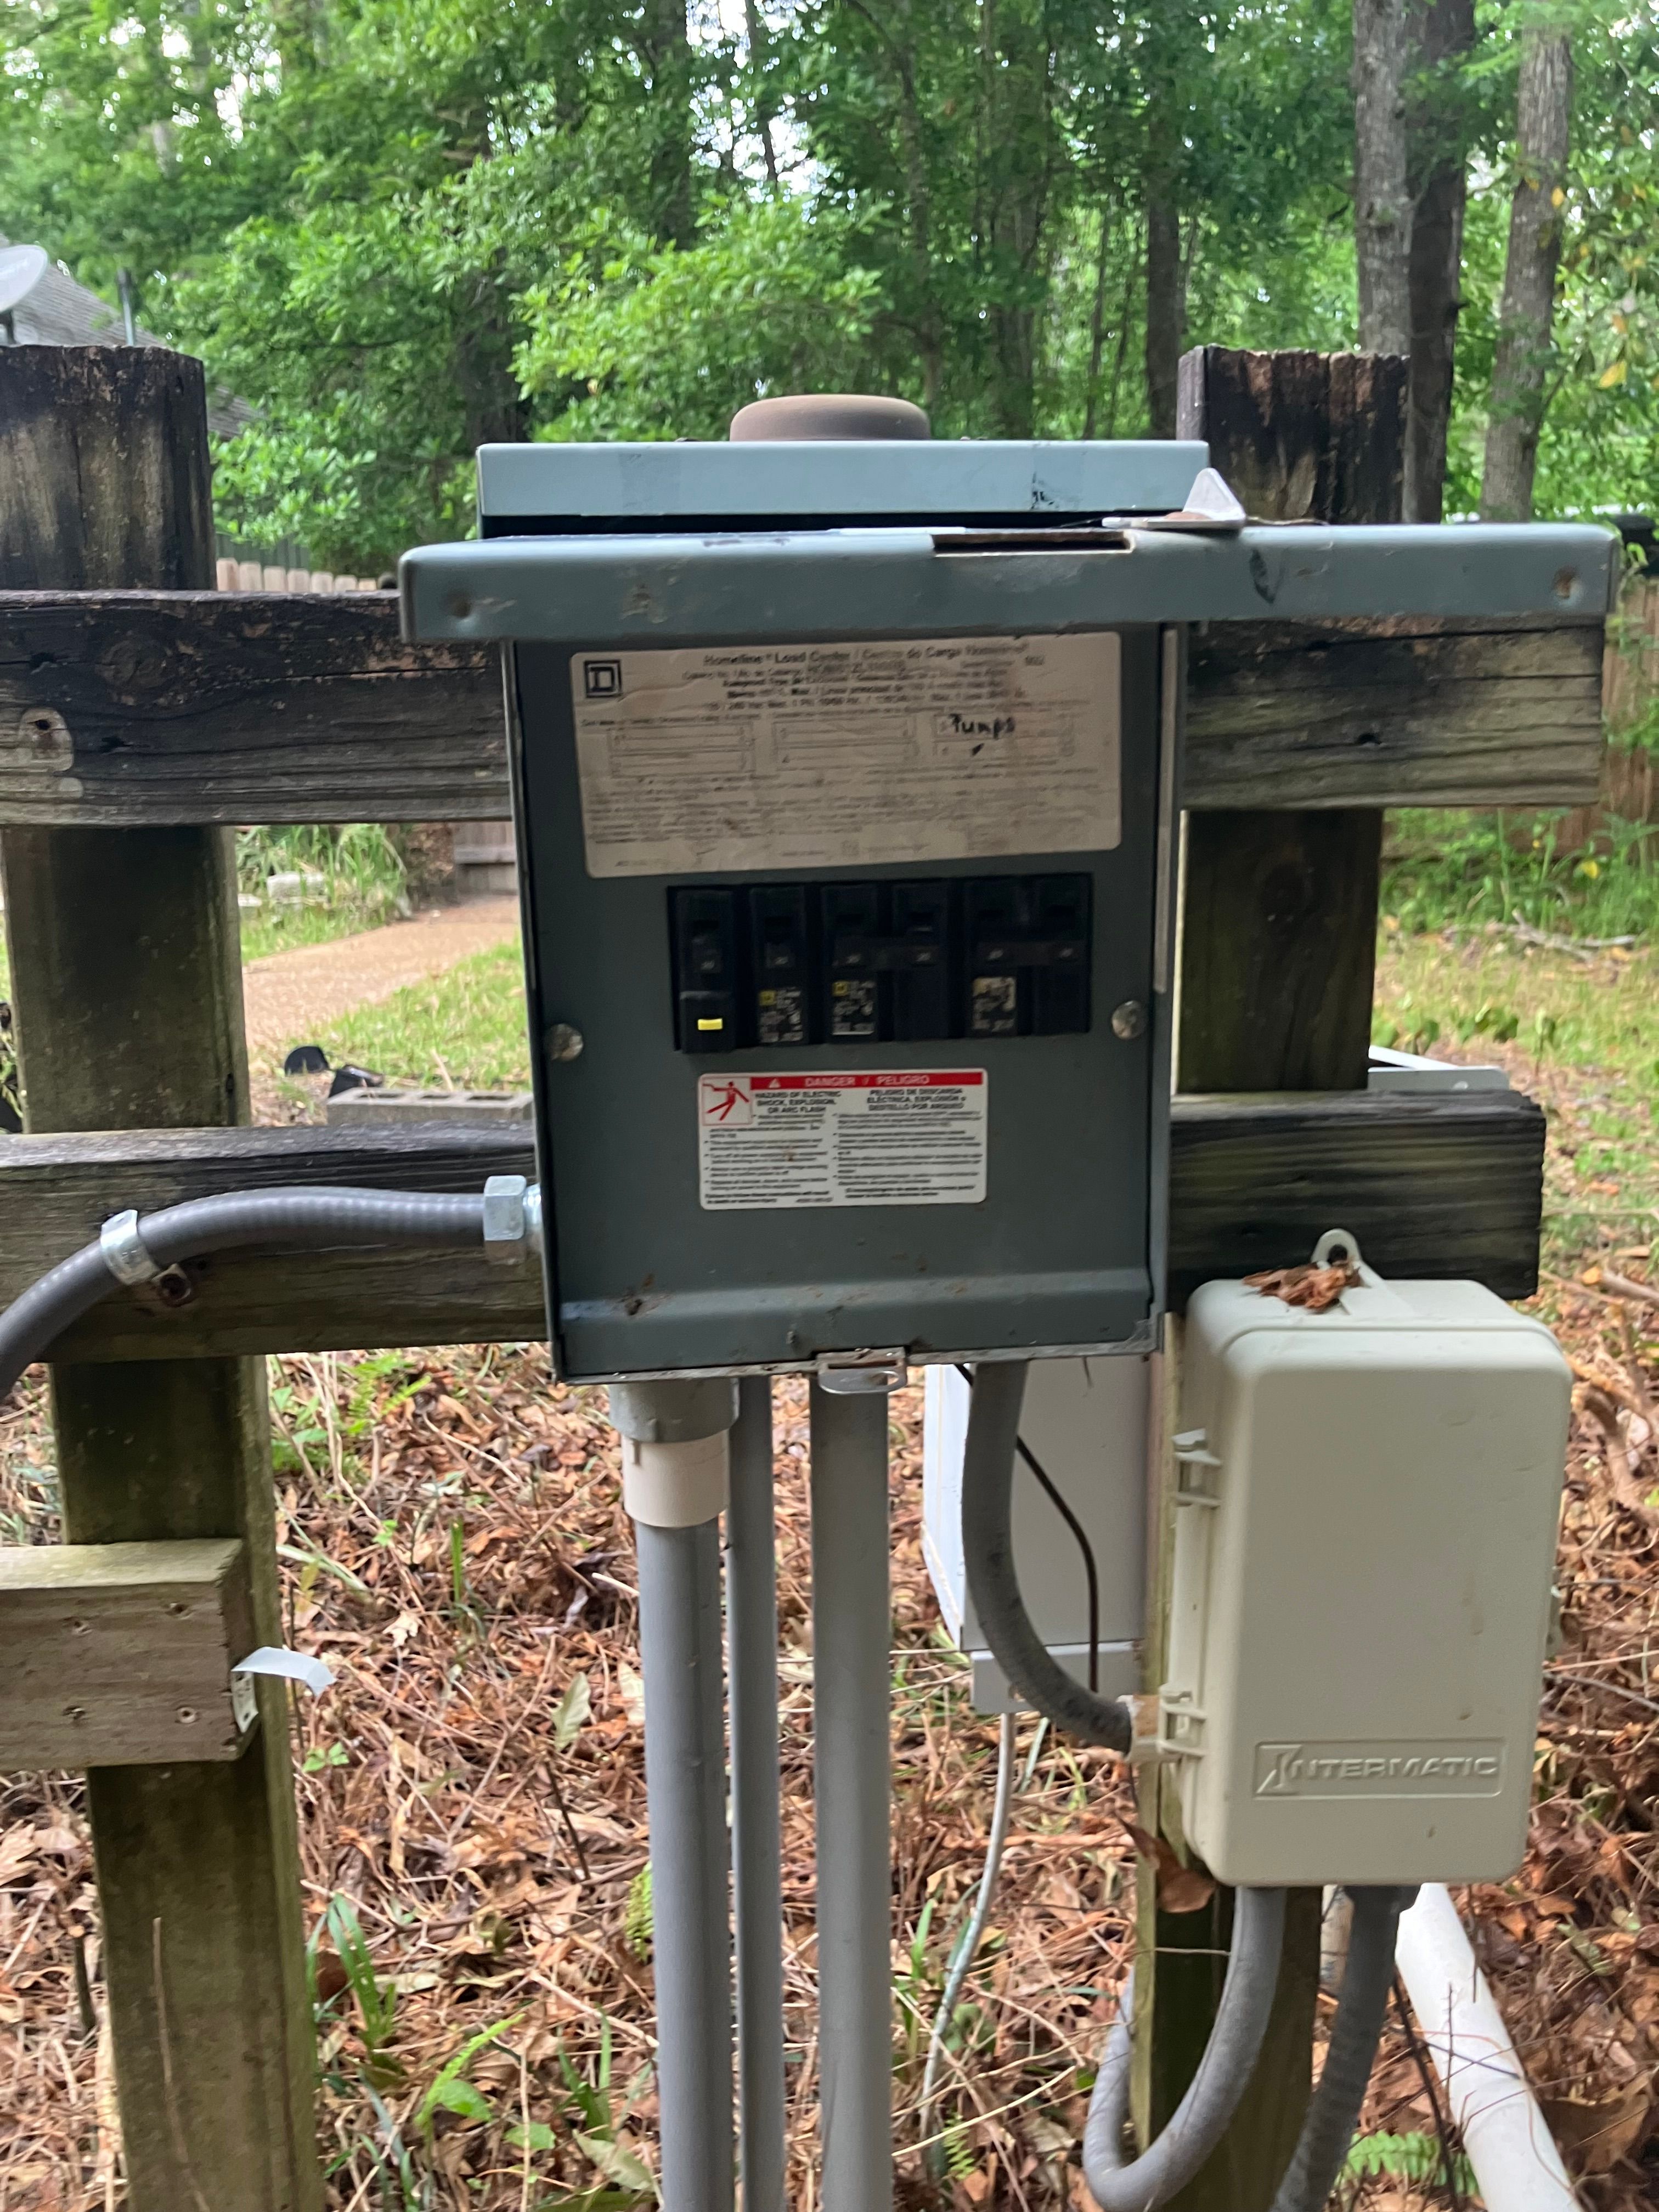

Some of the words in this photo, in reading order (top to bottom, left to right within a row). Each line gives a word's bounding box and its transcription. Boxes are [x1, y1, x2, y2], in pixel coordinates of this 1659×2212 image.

[775, 652, 806, 663] Load
[804, 1076, 855, 1087] DANGER
[875, 1074, 930, 1085] PELIGRO
[1257, 1744, 1498, 1794] INTERMATIC
